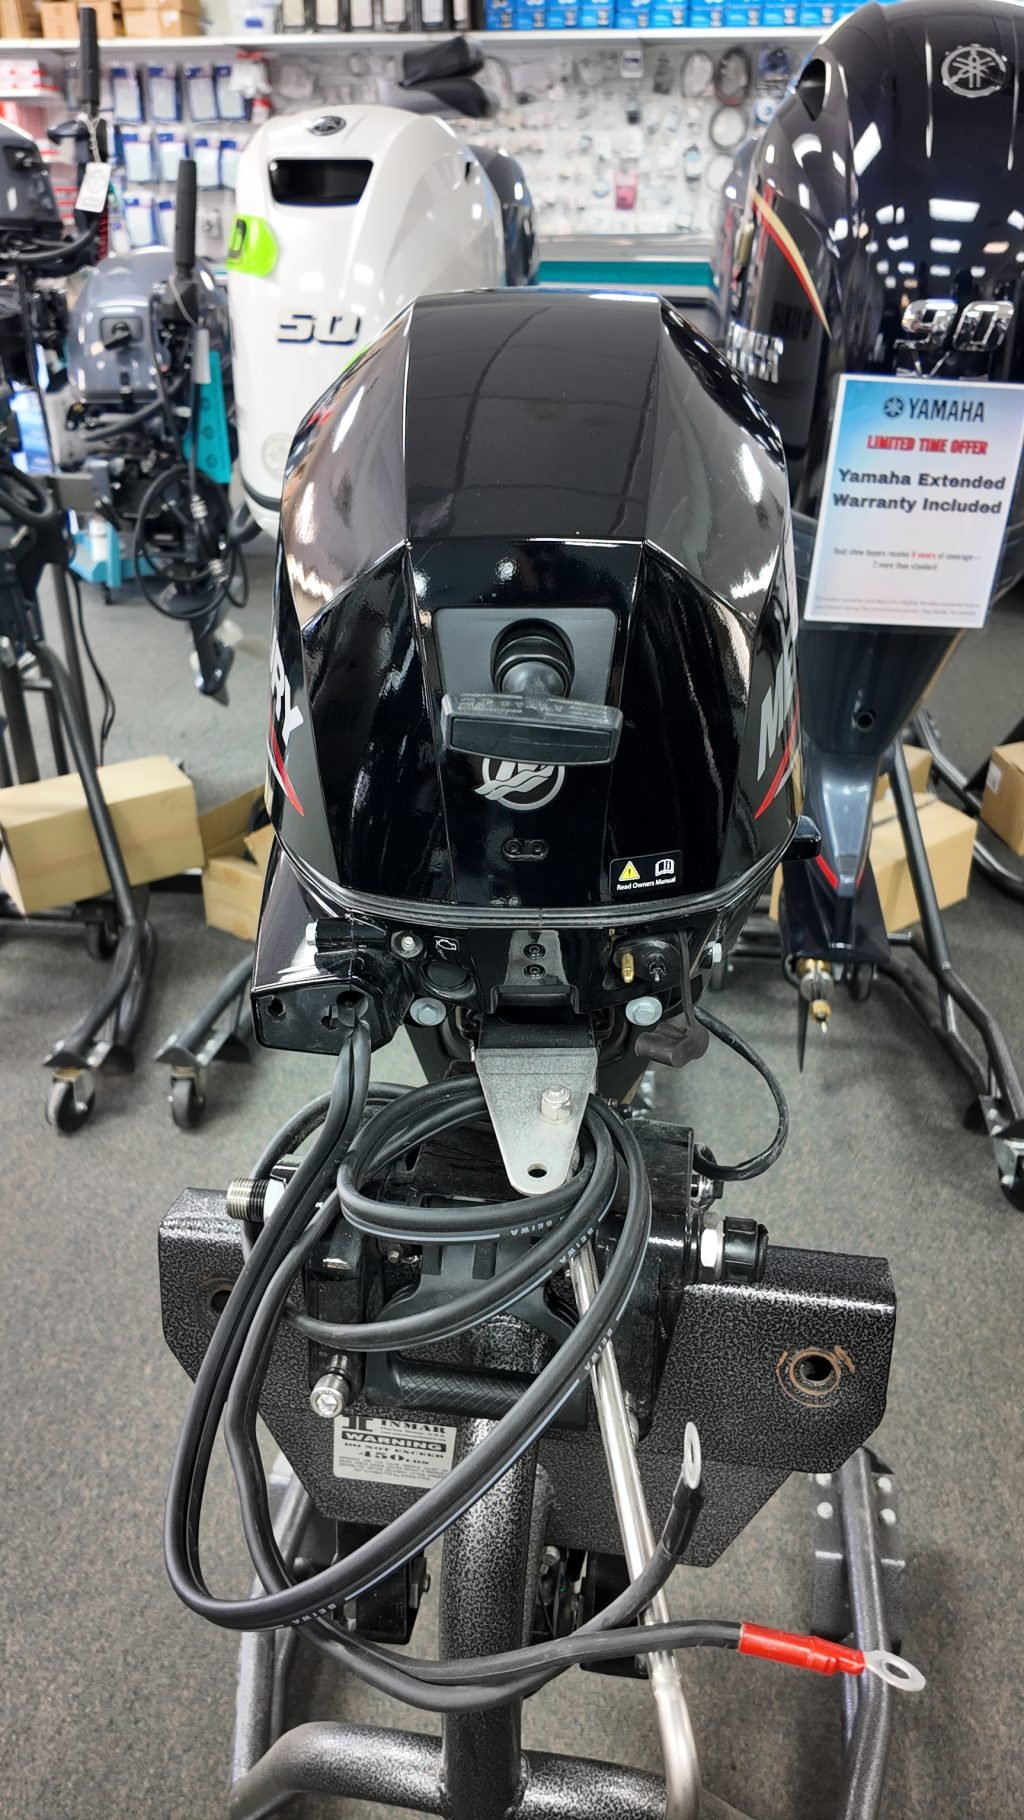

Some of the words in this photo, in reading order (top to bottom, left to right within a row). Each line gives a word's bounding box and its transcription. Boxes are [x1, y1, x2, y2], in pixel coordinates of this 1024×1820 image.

[277, 311, 362, 346] 50
[893, 299, 1014, 352] 90
[908, 398, 985, 423] YAMAHA
[867, 435, 915, 450] LIMITED
[919, 438, 948, 453] TIME
[950, 440, 989, 455] OFFER
[838, 468, 911, 486] Yamaha
[918, 473, 1006, 490] Extended
[832, 493, 917, 513] Warranty
[923, 497, 1002, 514] Included
[270, 626, 304, 747] RY
[616, 883, 632, 891] Read
[632, 880, 655, 888] Owners
[655, 876, 676, 885] Manual
[510, 1220, 553, 1236] SEIWA
[559, 1227, 594, 1264] SEIWA
[584, 1327, 613, 1371] SEIWA
[380, 1420, 446, 1434] INMAR
[345, 1432, 442, 1451] WARNING
[366, 1444, 388, 1452] NOT
[394, 1448, 444, 1459] EXCEED
[358, 1450, 404, 1461] 450
[291, 1603, 337, 1625] SEIWA
